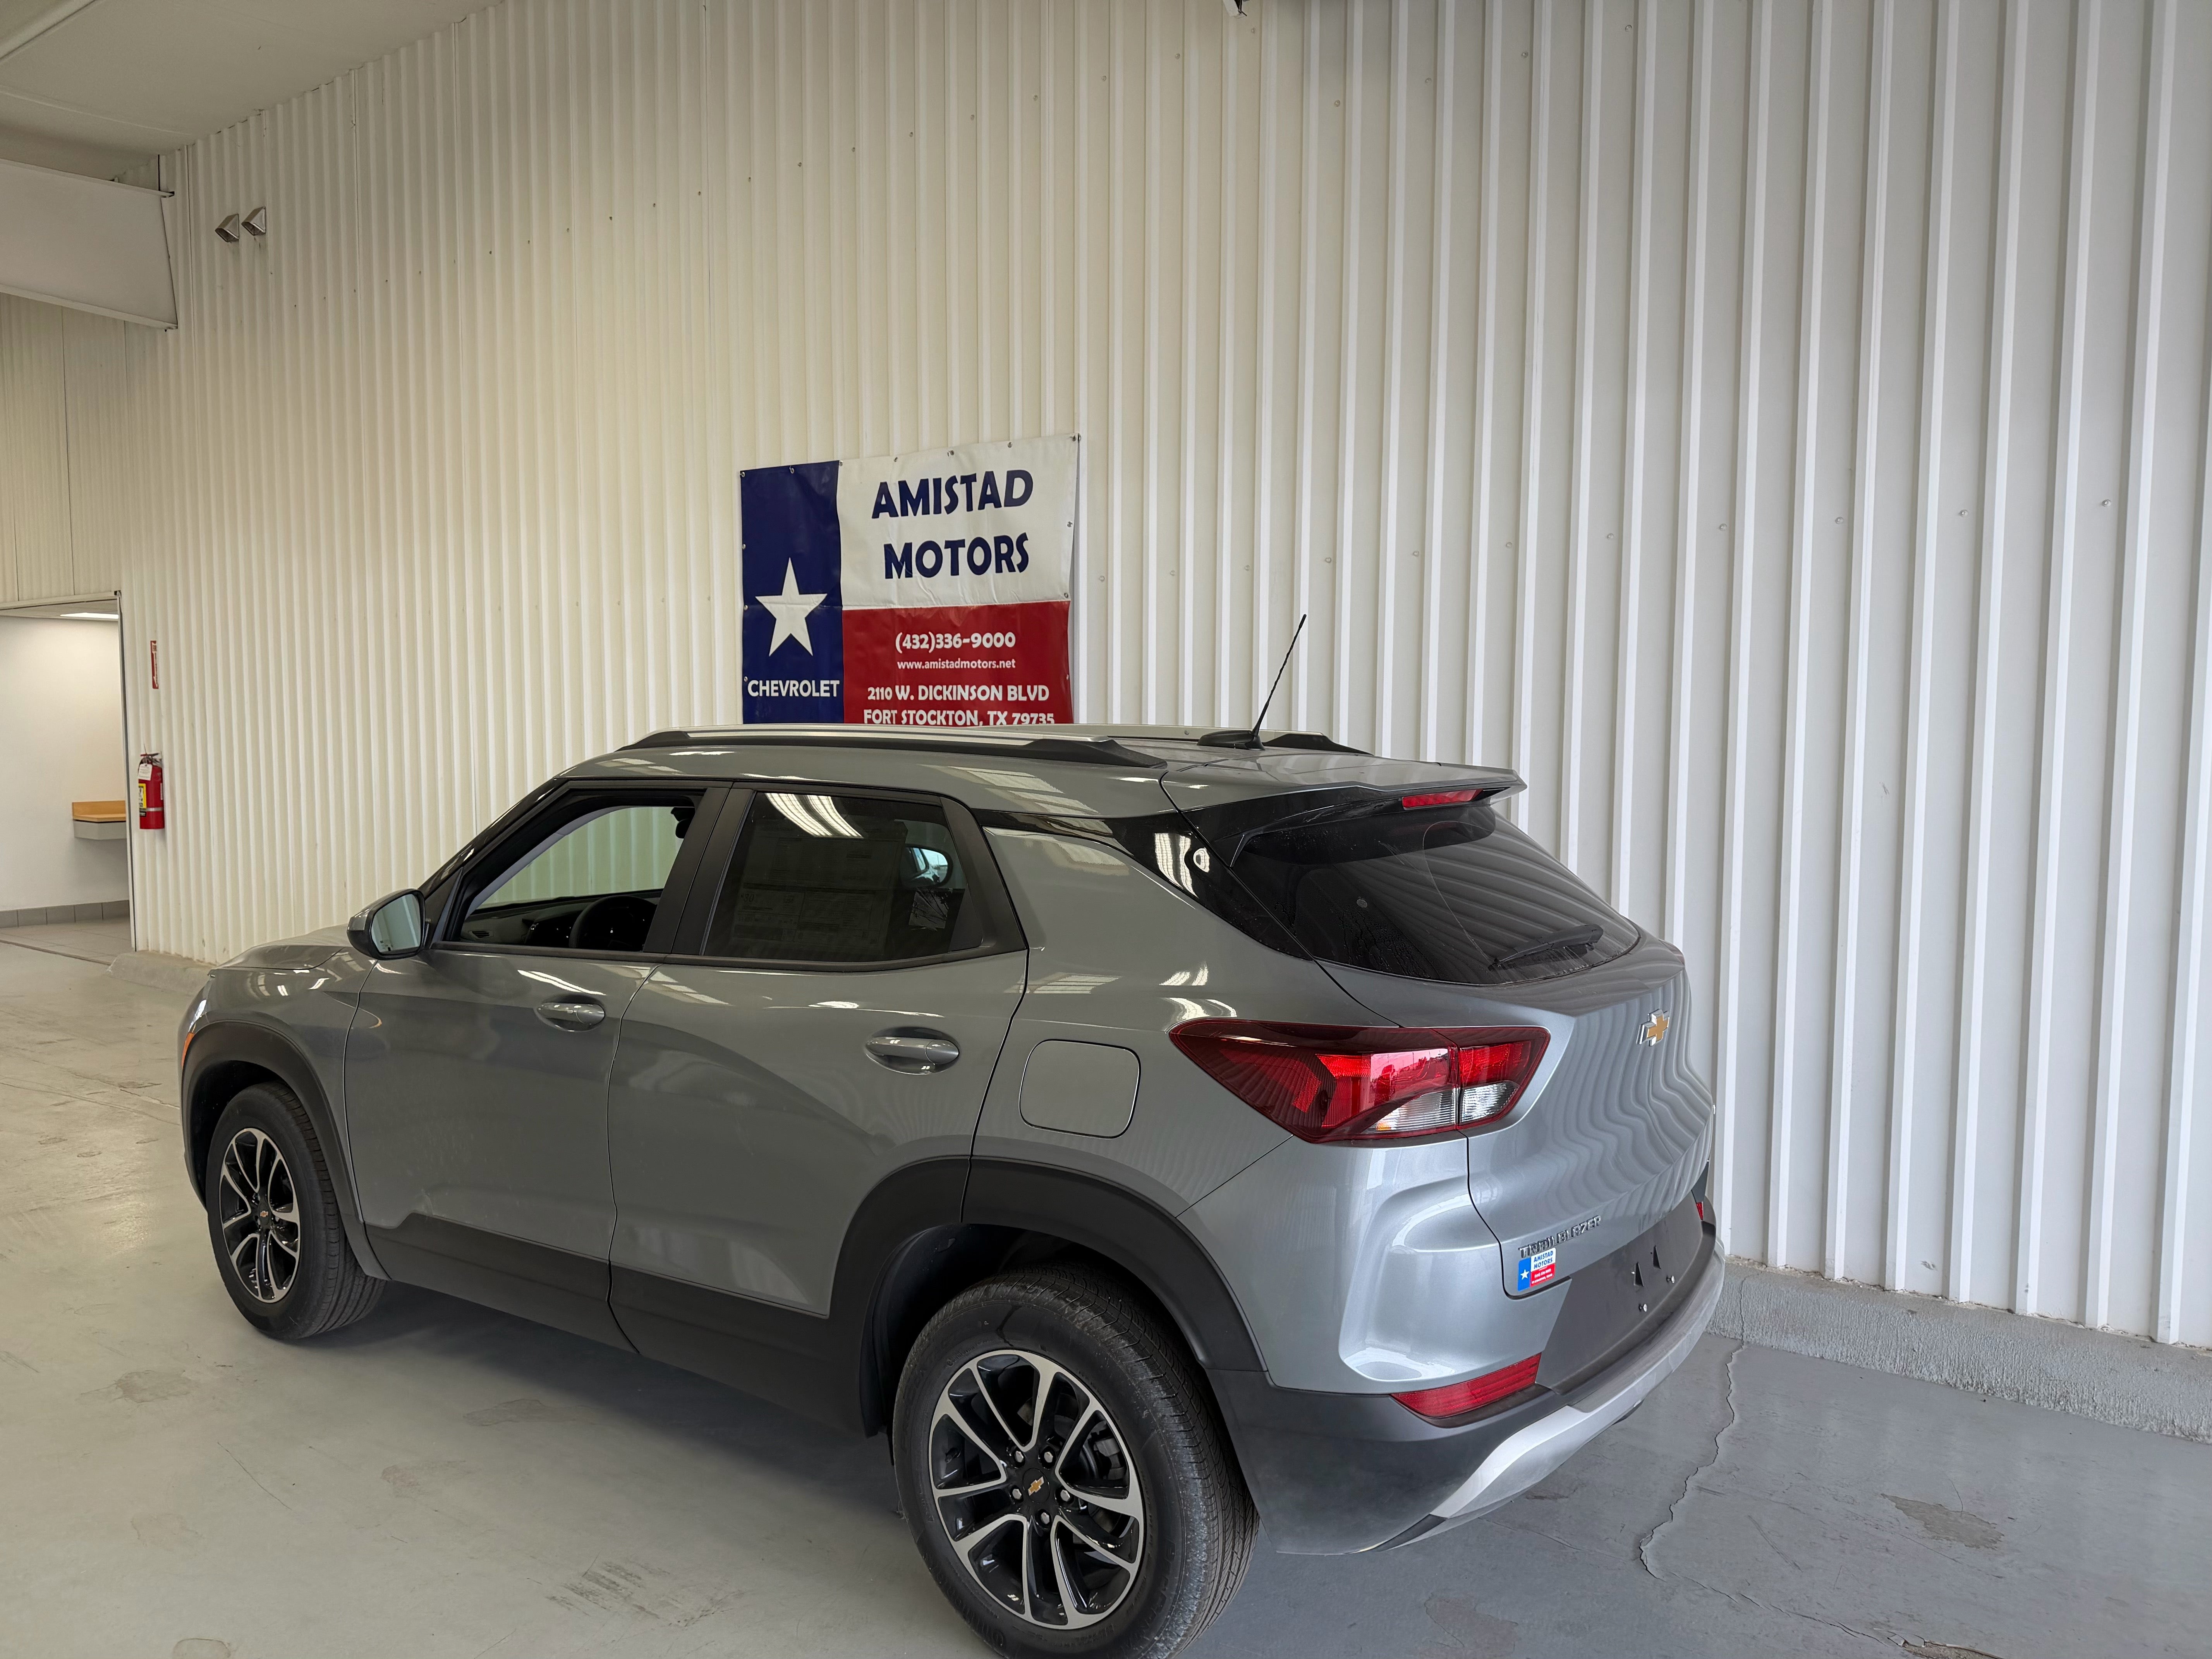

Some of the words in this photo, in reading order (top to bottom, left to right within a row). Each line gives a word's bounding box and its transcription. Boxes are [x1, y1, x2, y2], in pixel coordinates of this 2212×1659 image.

[871, 470, 1033, 519] AMISTAD
[884, 532, 1029, 579] MOTORS
[896, 632, 1016, 653] (432)336-9000
[897, 658, 1016, 669] www.amistadmotors.net
[747, 680, 840, 697] CHEVROLET
[867, 687, 892, 700] 2110
[895, 685, 914, 700] W.
[918, 685, 1003, 701] DICKINSON
[1007, 685, 1049, 701] BLVD
[864, 709, 898, 724] FORT
[901, 709, 983, 726] STOCKTON,
[987, 711, 1008, 725] TX
[1012, 713, 1055, 725] 79735
[1534, 1250, 1553, 1262] AMISTAD
[1534, 1257, 1553, 1269] MOTORS
